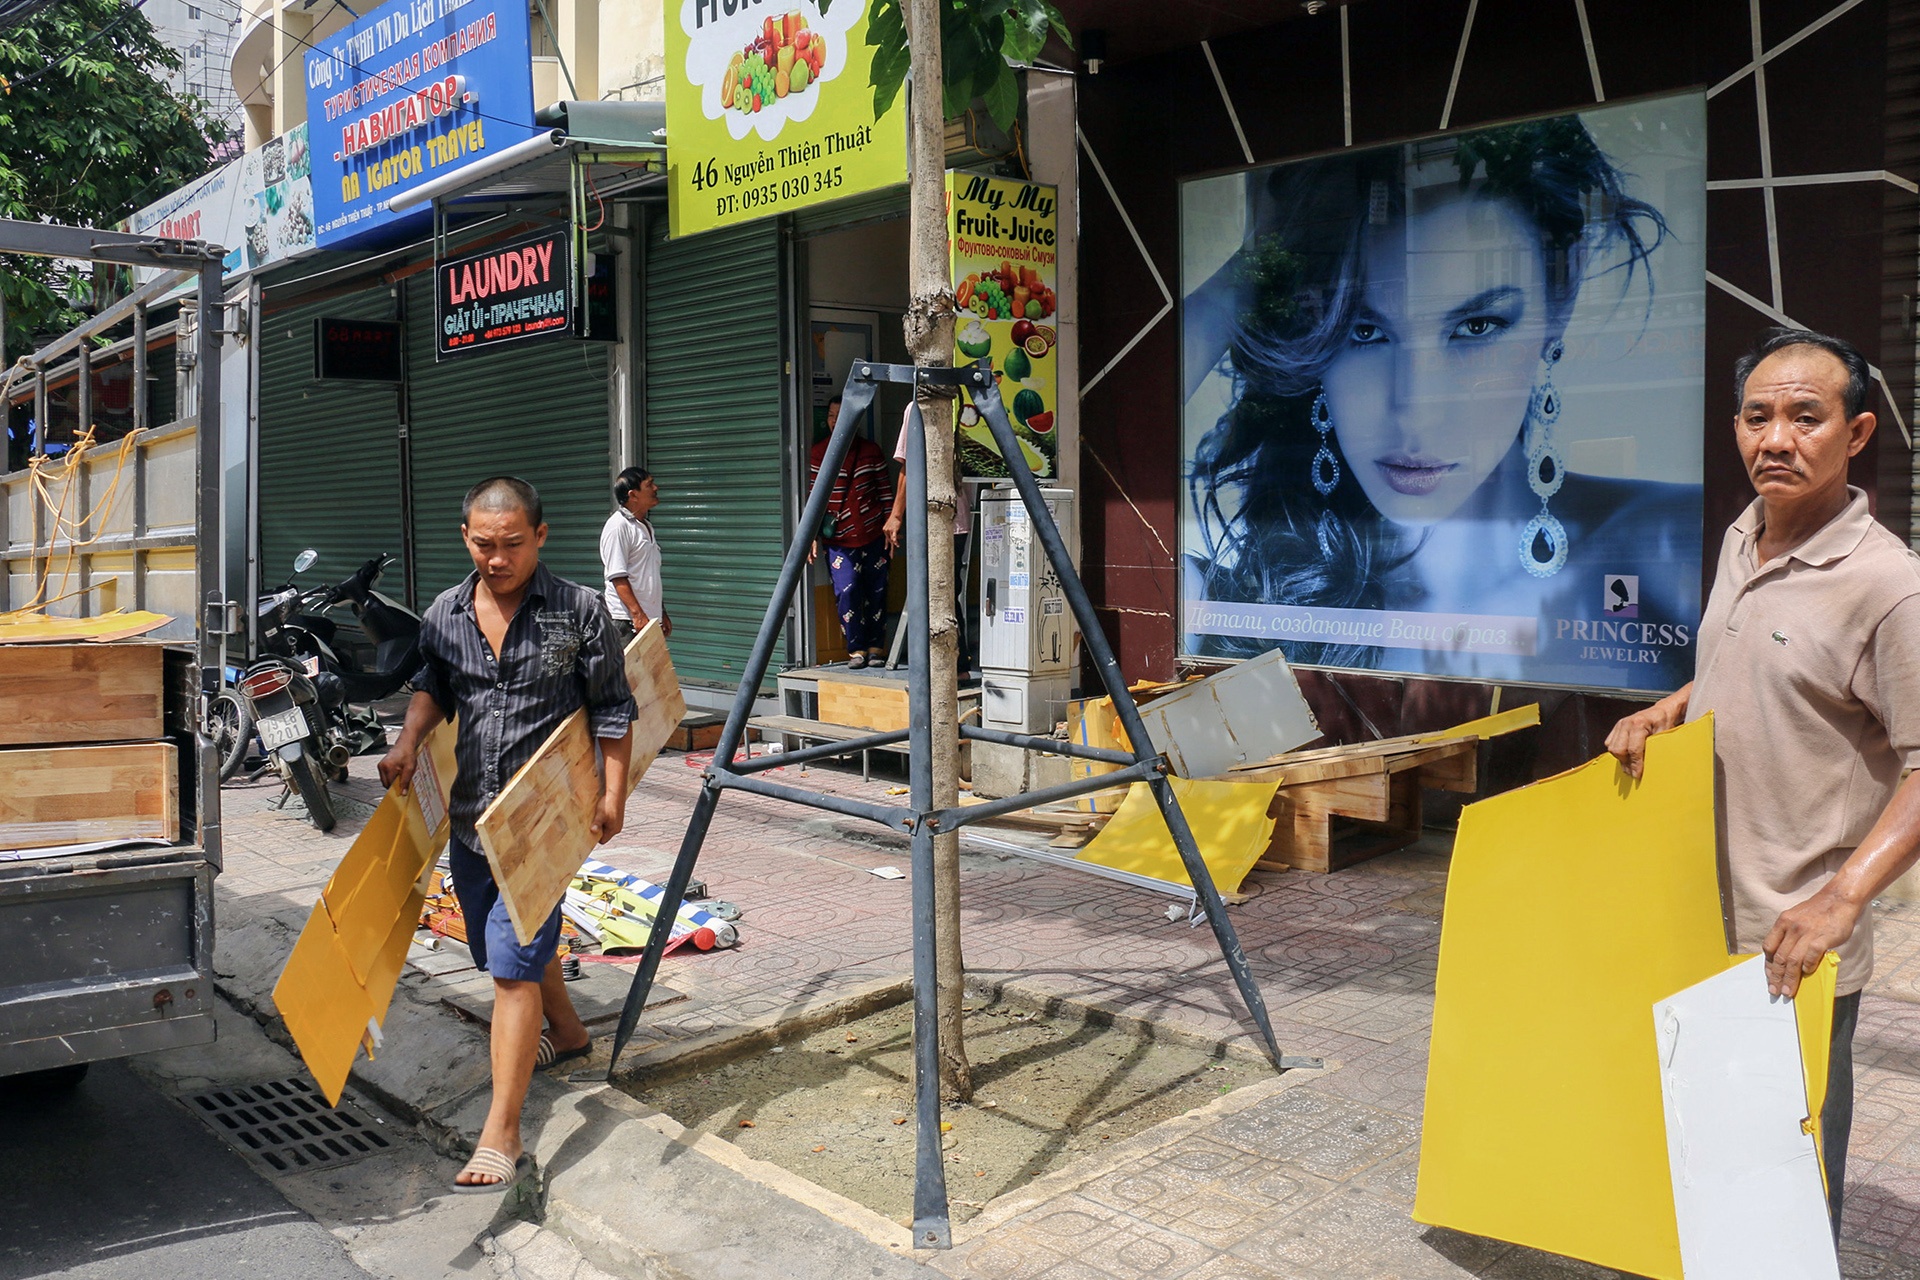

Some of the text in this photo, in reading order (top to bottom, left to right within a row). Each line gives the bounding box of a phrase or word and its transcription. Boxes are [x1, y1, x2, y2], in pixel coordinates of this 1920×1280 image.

[309, 59, 331, 89] Công
[333, 46, 345, 80] Ty
[376, 16, 392, 52] TM
[393, 11, 409, 43] Du
[324, 12, 497, 122] ТУРИСТИЧЕСКАЯ КОМПАНИЯ
[342, 75, 460, 157] НАВИГАТОР
[426, 119, 486, 169] TRAVEL
[691, 125, 872, 191] 46 Nguyễn Thiện Thuật
[716, 165, 843, 216] ĐT: 0935 030 345
[957, 176, 1006, 211] My
[1009, 184, 1055, 219] My
[449, 240, 554, 305] LAUNDRY
[957, 236, 1055, 268] Фруктово-соковый Смузи
[1186, 607, 1267, 635] Детали,
[1271, 612, 1384, 642] создающие
[1387, 618, 1437, 642] Ваш
[1555, 618, 1690, 647] PRINCESS
[1580, 646, 1662, 664] JEWELRY
[268, 724, 300, 745] 2201
